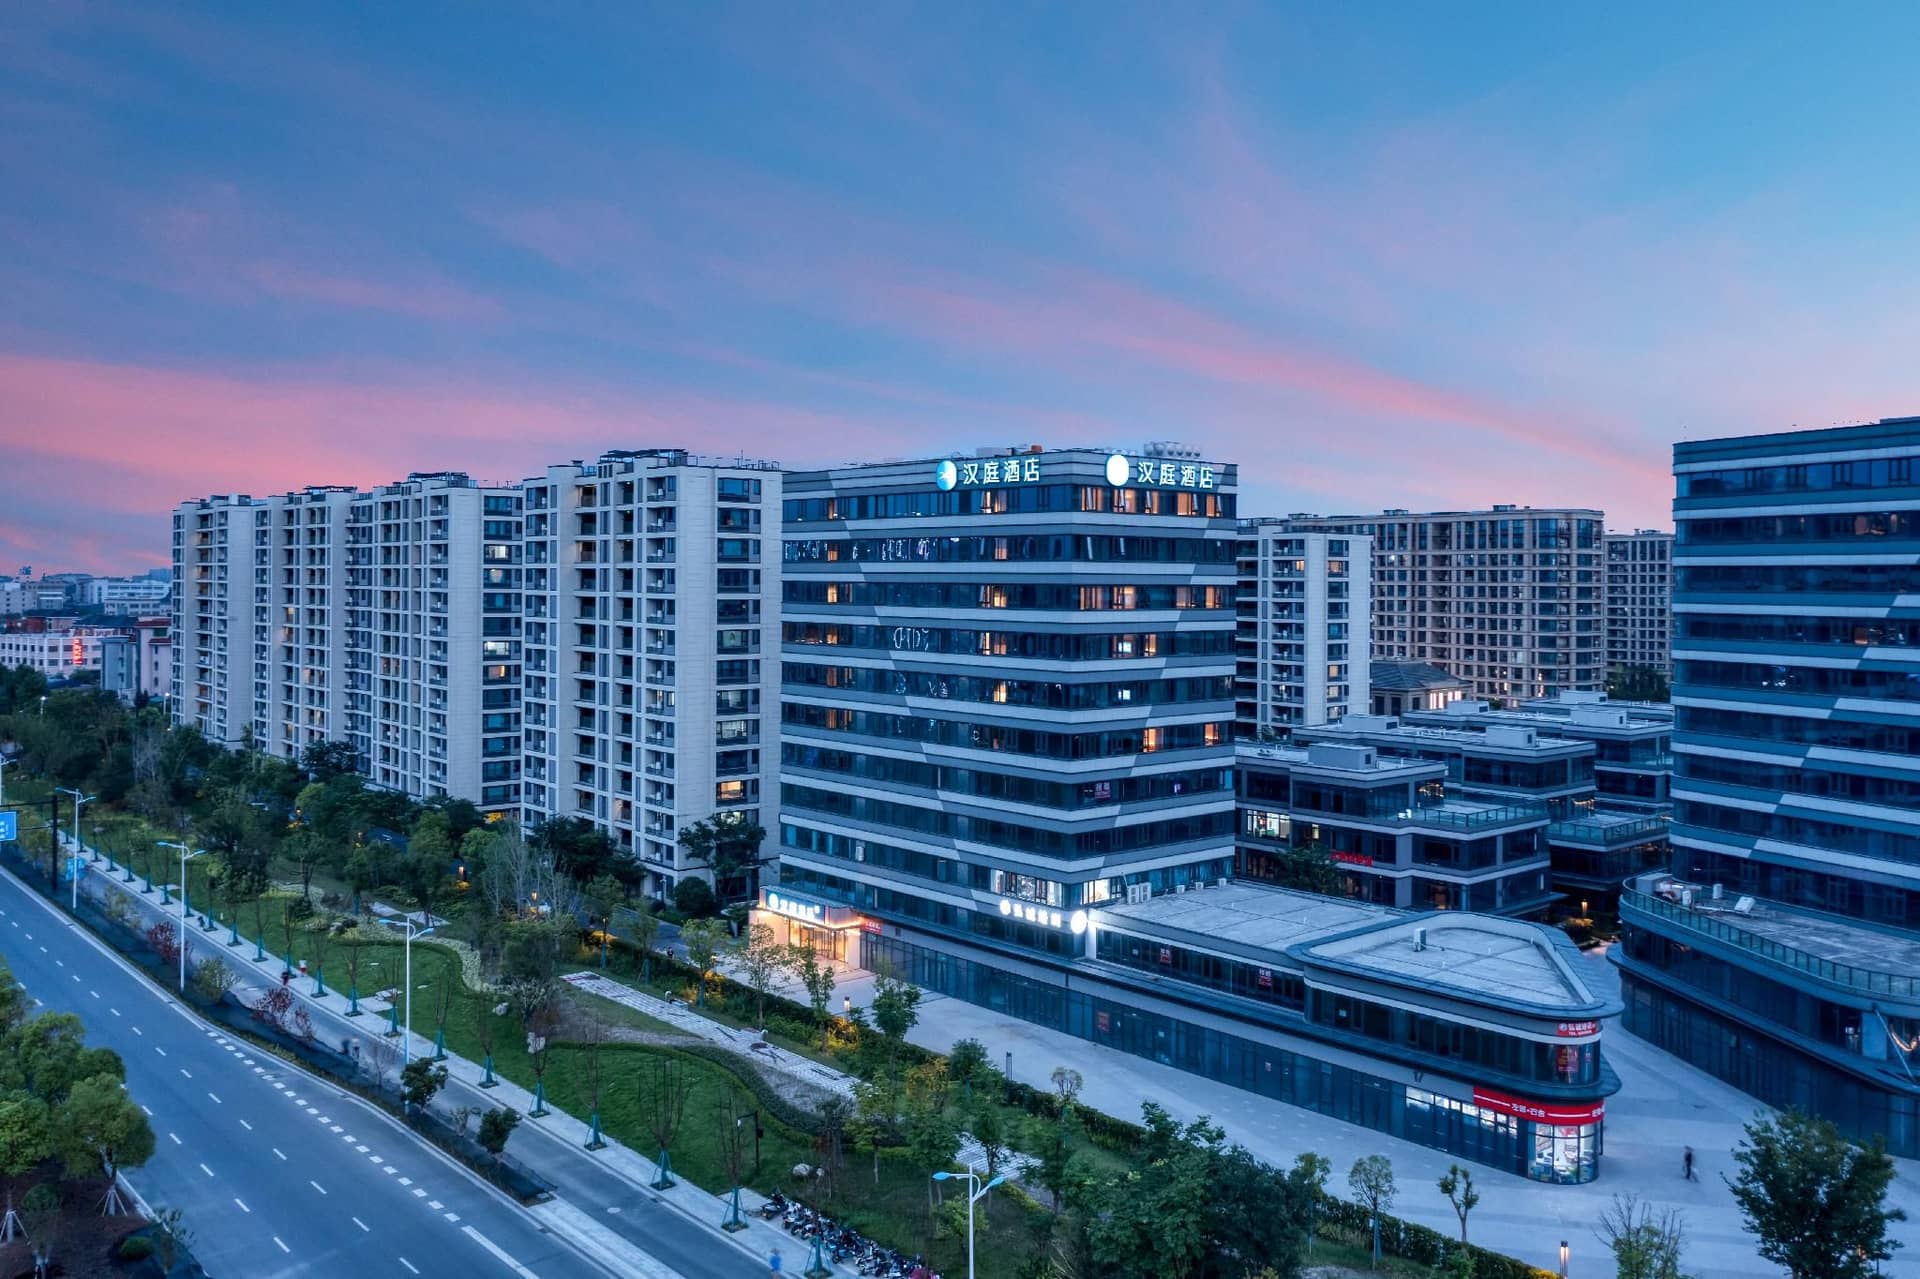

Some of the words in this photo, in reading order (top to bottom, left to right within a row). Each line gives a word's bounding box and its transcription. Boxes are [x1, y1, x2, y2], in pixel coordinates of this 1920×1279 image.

[963, 458, 1040, 485] 汉庭酒店
[1138, 461, 1214, 489] 汉庭酒店
